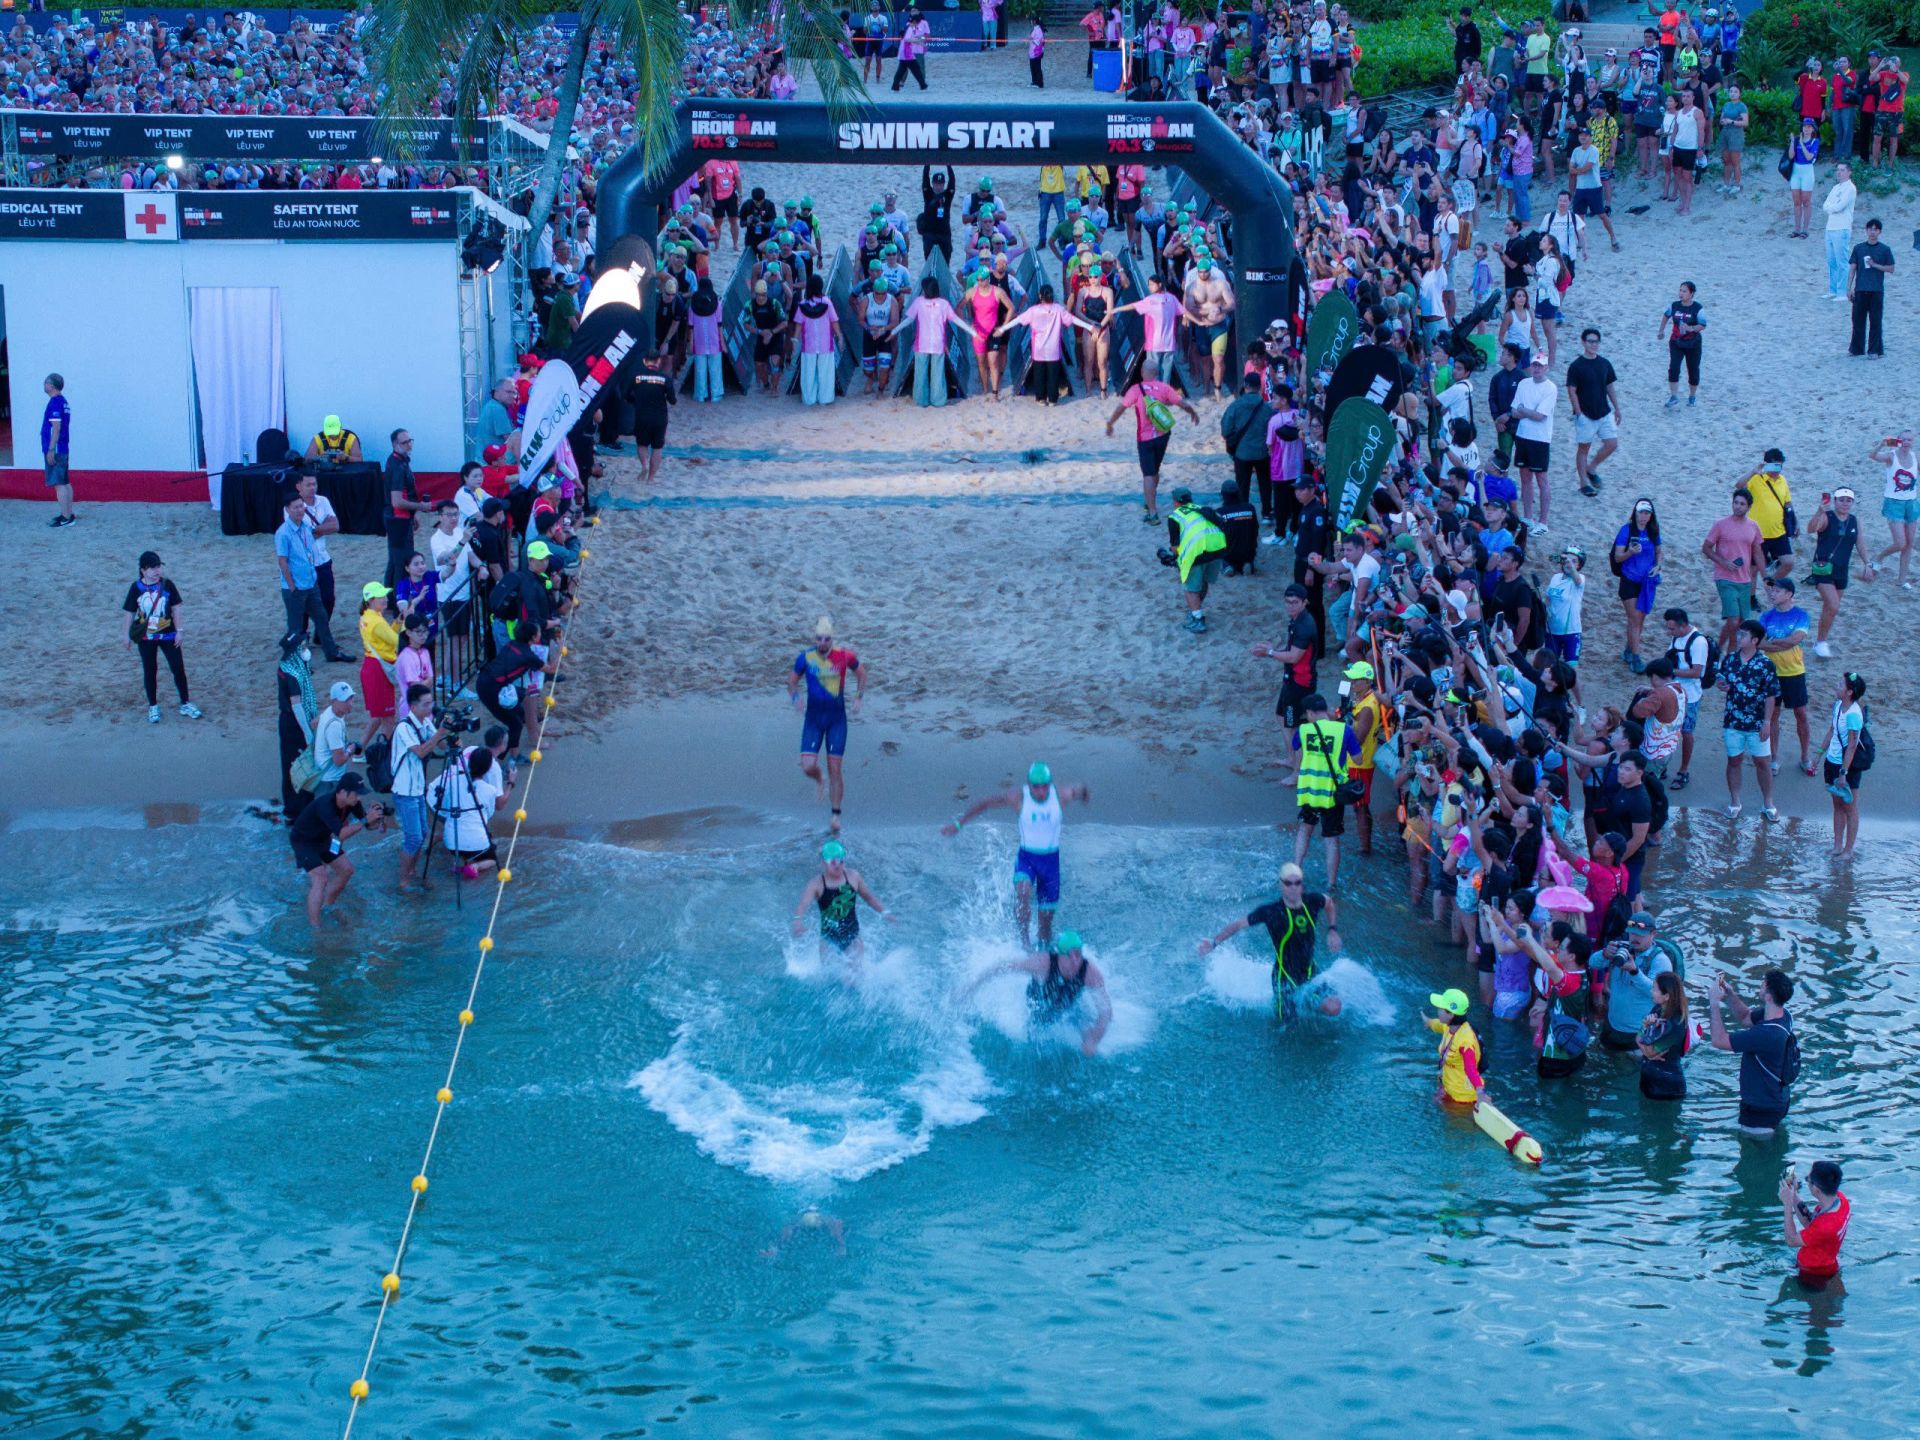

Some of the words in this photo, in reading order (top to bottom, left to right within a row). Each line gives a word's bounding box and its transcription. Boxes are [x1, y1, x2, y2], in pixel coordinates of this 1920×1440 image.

[692, 110, 735, 119] BIMGroup
[1107, 114, 1152, 122] BIMGroup
[692, 113, 777, 135] IRONMAN
[1107, 116, 1194, 138] IRONMAN
[63, 126, 81, 136] VIP
[83, 127, 111, 137] TENT
[144, 128, 162, 138] VIP
[164, 128, 192, 138] TENT
[225, 129, 244, 139] VIP
[246, 129, 274, 139] TENT
[307, 130, 326, 139] VIP
[328, 130, 357, 139] TENT
[391, 131, 408, 140] VIP
[411, 131, 440, 140] TENT
[839, 123, 939, 149] SWIM
[947, 121, 1055, 149] START
[692, 135, 725, 149] 70.3
[1108, 138, 1141, 152] 70.3
[0, 203, 48, 214] EDICAL
[49, 204, 83, 214] TENT
[273, 204, 323, 215] SAFETY
[325, 204, 359, 215] TENT
[37, 219, 44, 227] Y
[292, 219, 305, 228] AN
[307, 218, 332, 228] TOÀN
[1245, 271, 1287, 281] BIMGroup
[580, 330, 636, 414] ONMAN
